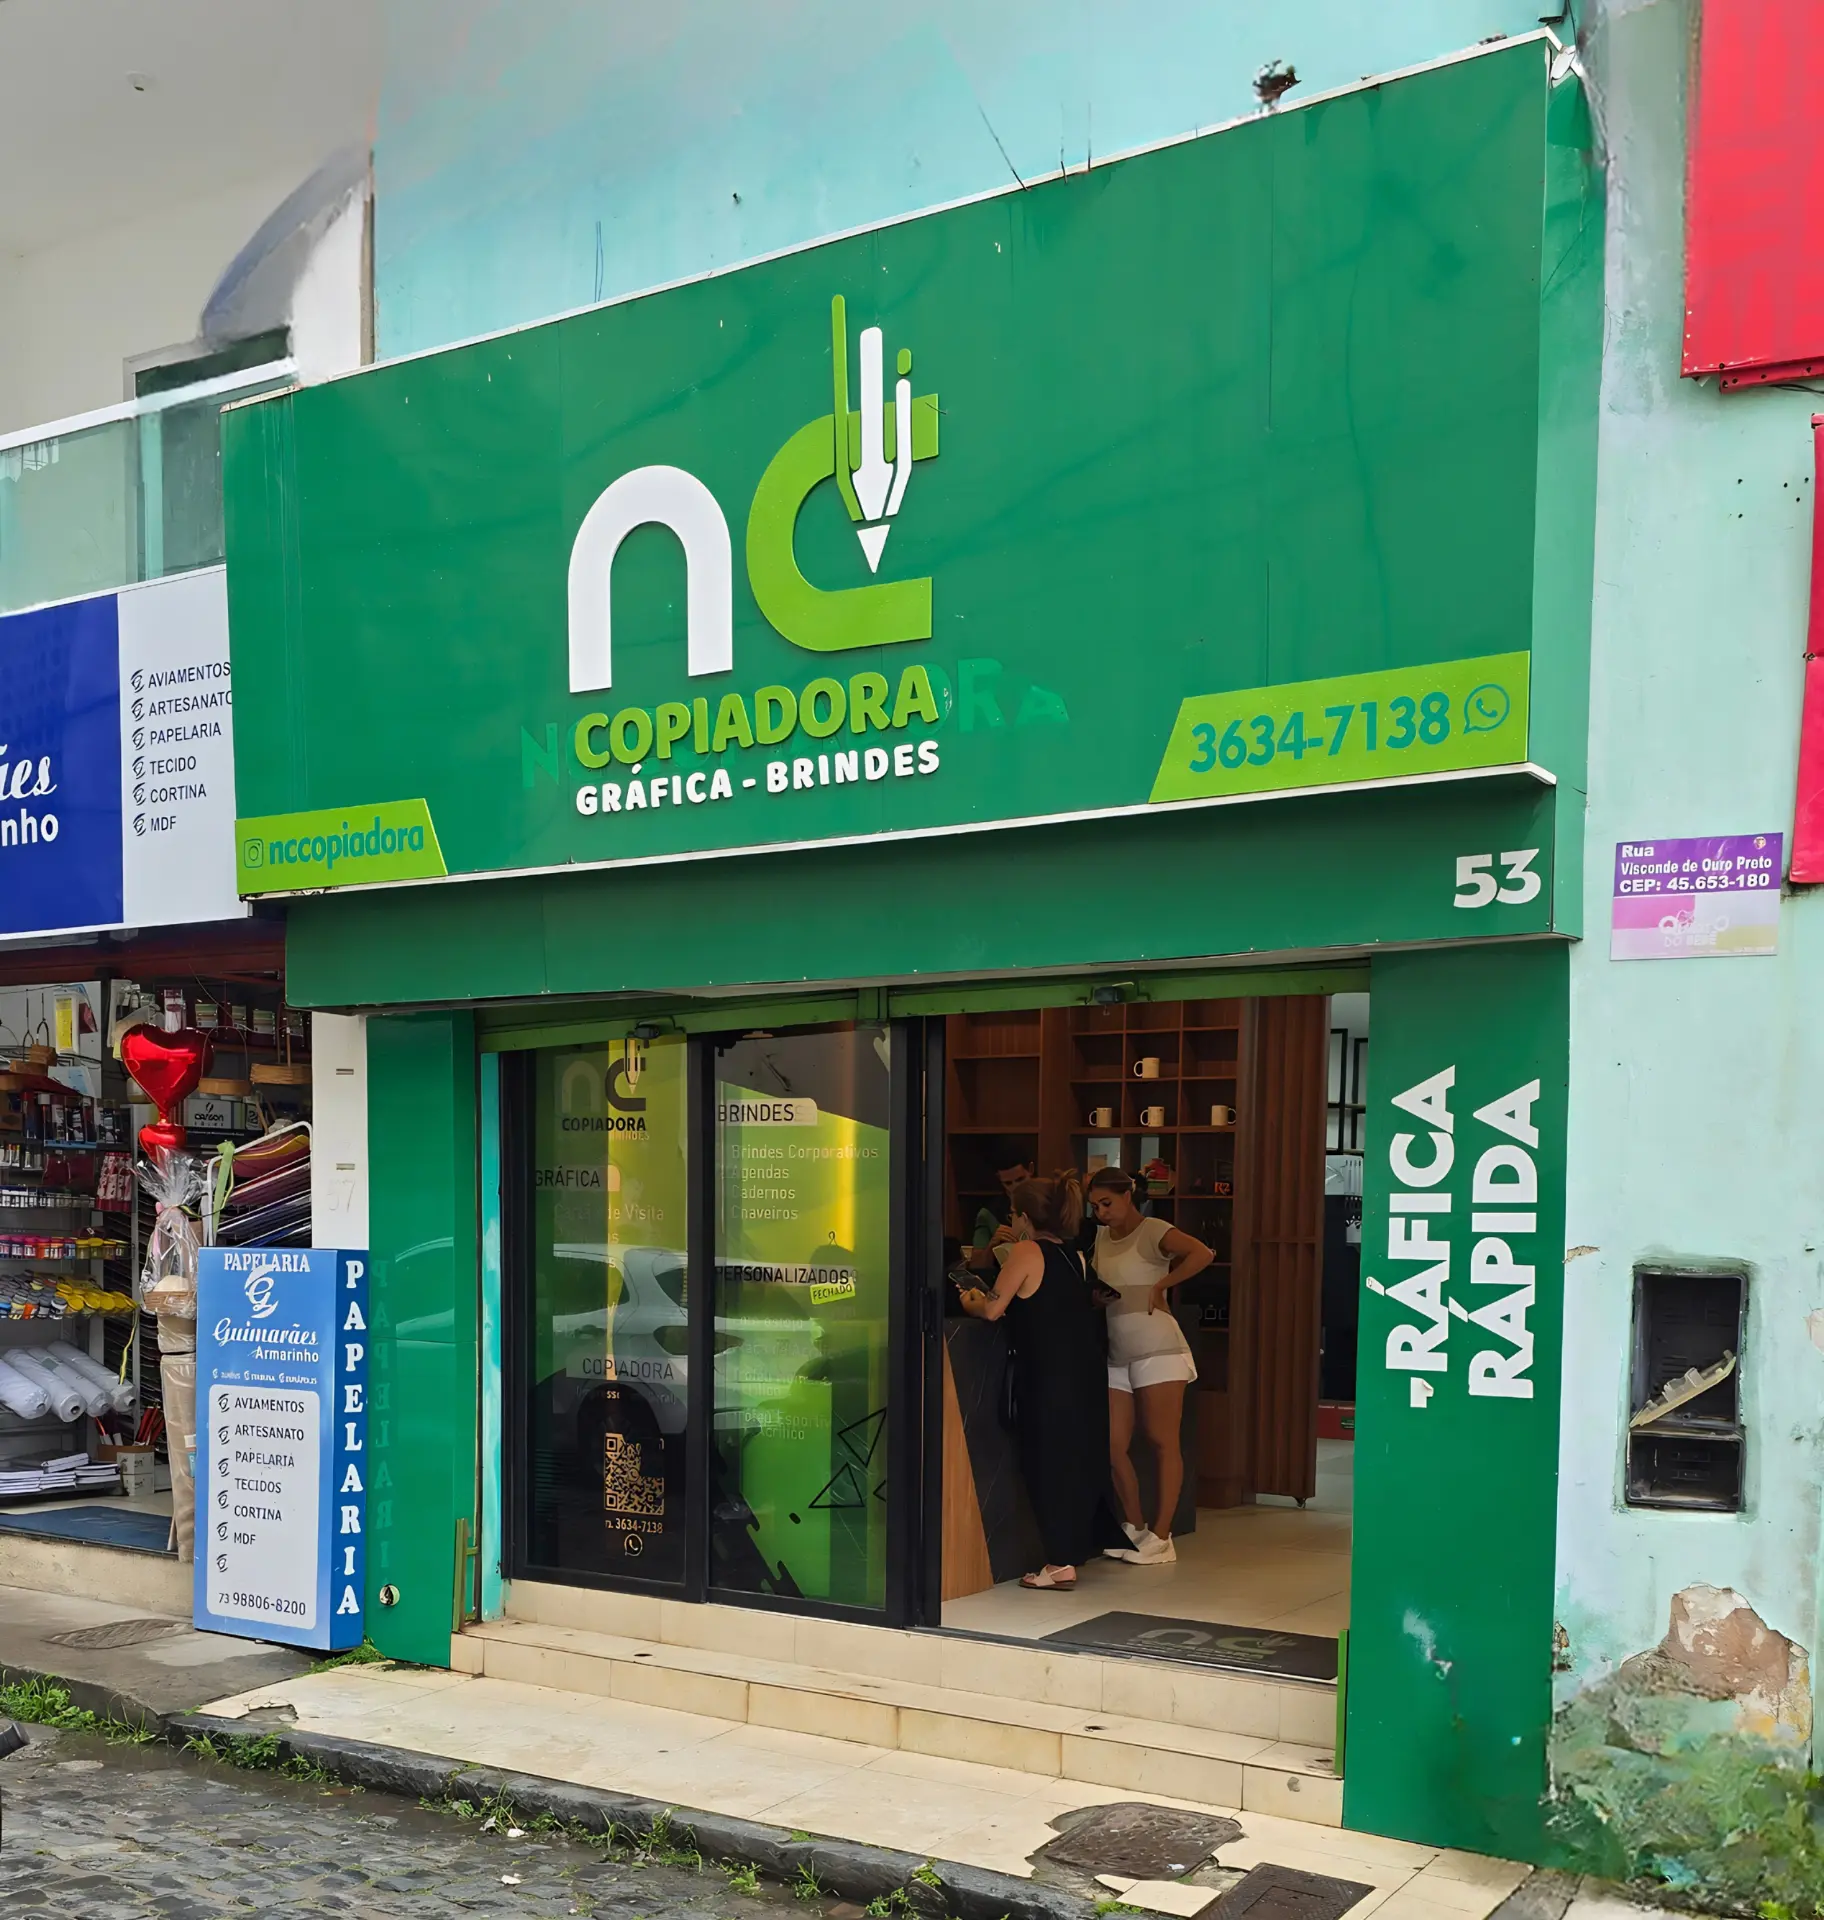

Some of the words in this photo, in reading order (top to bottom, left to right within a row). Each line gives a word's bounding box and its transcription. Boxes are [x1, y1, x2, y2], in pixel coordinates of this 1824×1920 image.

[148, 661, 231, 688] AVIAMENTOS
[575, 665, 939, 768] COPIADORA
[150, 722, 222, 745] PAPELARIA
[1188, 692, 1450, 772] 3634-7138
[150, 756, 197, 775] TECIDO
[576, 764, 732, 816] GRÁFICA
[766, 740, 940, 794] BRINDES
[150, 783, 207, 804] CORTINA
[150, 816, 177, 832] MDF
[269, 822, 424, 869] nccopiadora
[1621, 844, 1654, 858] Rua
[1621, 860, 1678, 876] Visconde
[1682, 859, 1698, 873] de
[1702, 857, 1733, 872] Ouro
[1736, 855, 1772, 871] Preto
[1453, 848, 1542, 909] 53
[1619, 878, 1661, 893] CEP:
[1666, 873, 1770, 892] 45.653-180
[718, 1104, 794, 1122] BRINDES
[562, 1117, 646, 1132] COPIADORA
[731, 1145, 784, 1160] Brindes
[788, 1145, 879, 1163] Corporativos
[535, 1165, 600, 1187] GRÁFICA
[1448, 1078, 1541, 1399] RÁPIDA
[223, 1252, 311, 1273] PAPELARIA
[812, 1283, 853, 1300] FECHADO
[212, 1317, 319, 1347] Guimarães
[247, 1345, 319, 1363] Armarinho
[582, 1358, 674, 1380] COPIADORA
[234, 1398, 305, 1413] AVIAMENTOS
[234, 1424, 304, 1441] ARTESANATO
[336, 1259, 367, 1615] PAPELARIA
[234, 1450, 295, 1468] PAPELARIA
[234, 1478, 282, 1494] TECIDOS
[233, 1506, 283, 1522] CORTINA
[615, 1518, 663, 1534] 3634-7138
[233, 1532, 257, 1545] MDF
[218, 1592, 231, 1604] 73
[232, 1592, 307, 1616] 98806-8200
